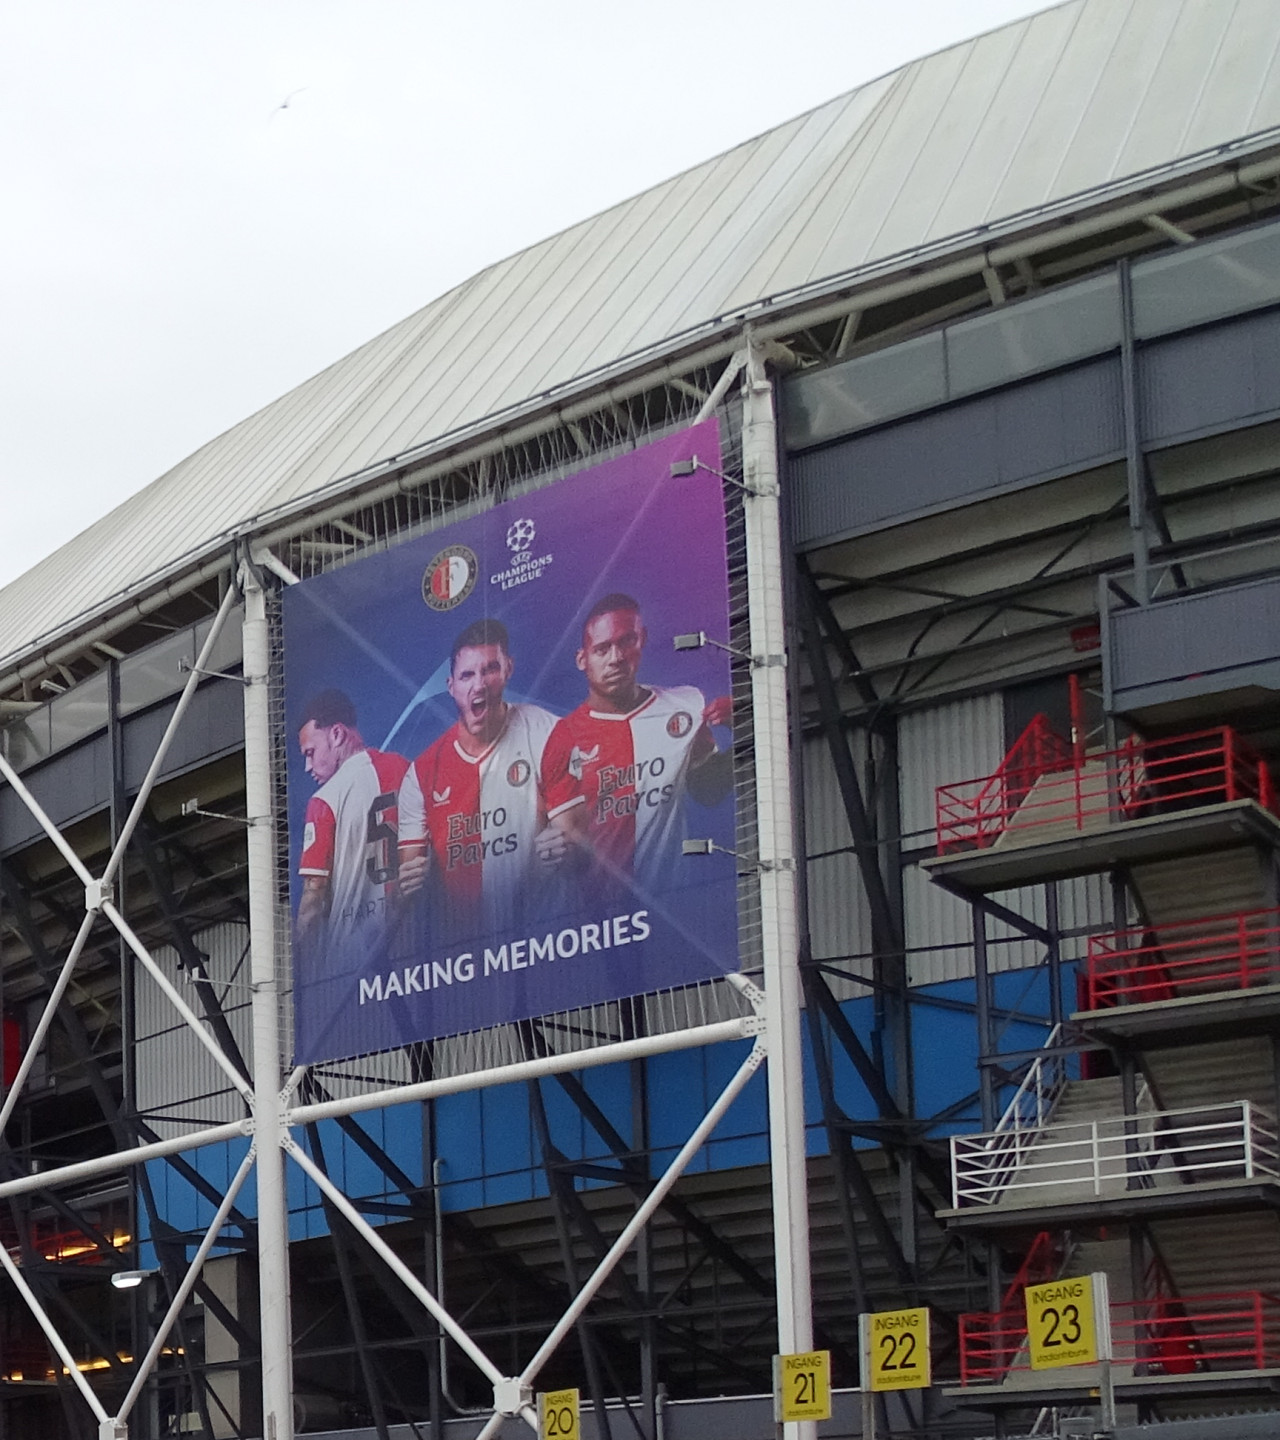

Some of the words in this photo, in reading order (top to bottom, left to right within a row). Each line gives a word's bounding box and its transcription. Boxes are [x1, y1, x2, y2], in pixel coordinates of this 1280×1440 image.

[490, 554, 553, 584] CHAMPIONS
[501, 568, 542, 591] LEAGUE
[597, 757, 665, 794] Euro
[597, 784, 674, 824] Parcs
[446, 807, 507, 843] Euro
[446, 833, 518, 871] Parcs
[359, 953, 475, 1005] MAKING
[483, 910, 651, 976] MEMORIES
[1033, 1284, 1083, 1304] INGANG
[875, 1314, 919, 1330] INGANG
[1040, 1305, 1081, 1347] 23
[785, 1356, 822, 1369] INGANG
[880, 1332, 916, 1371] 22
[794, 1373, 816, 1404] 21
[546, 1407, 574, 1436] 20
